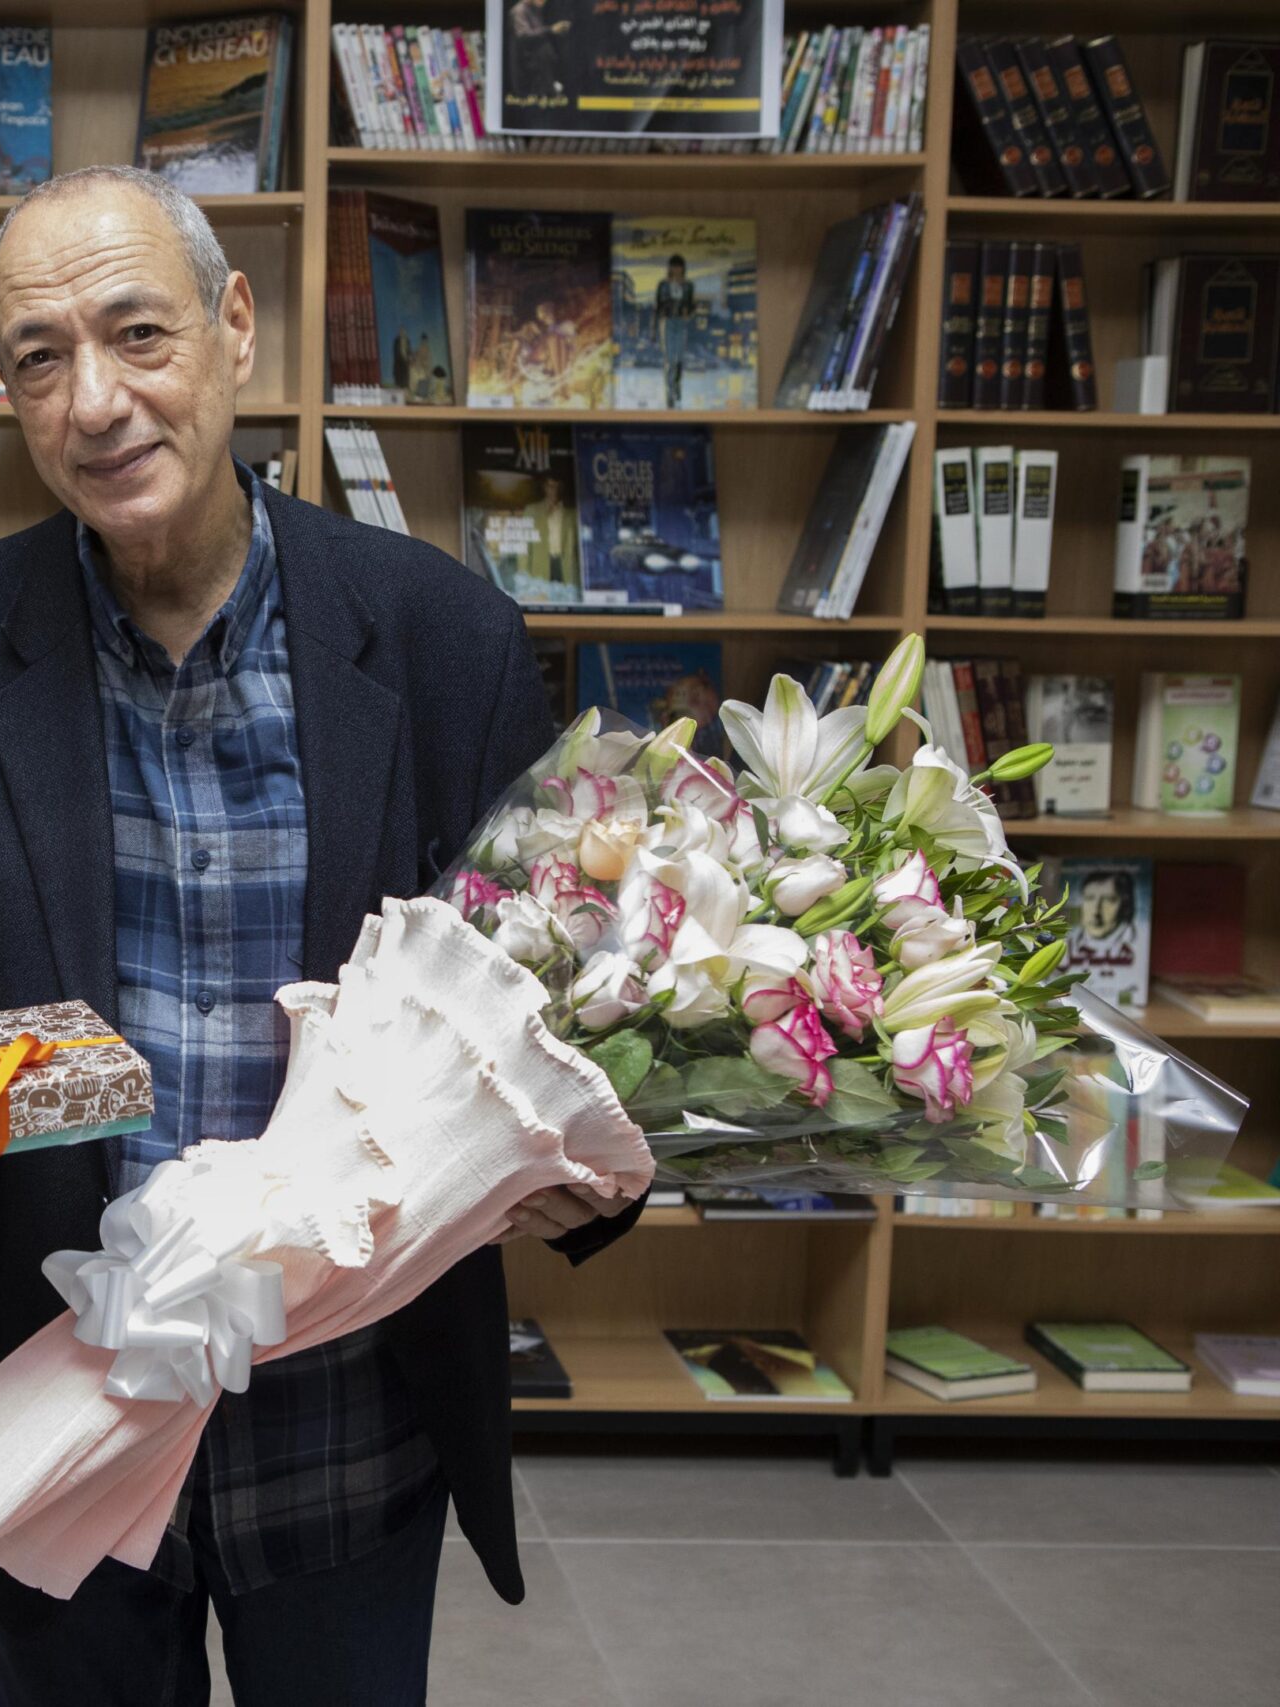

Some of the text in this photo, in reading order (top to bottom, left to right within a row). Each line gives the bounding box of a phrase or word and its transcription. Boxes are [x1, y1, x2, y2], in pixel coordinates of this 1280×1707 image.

[514, 425, 550, 471] XIII
[592, 452, 654, 482] CERCLES
[606, 481, 654, 501] POUVOIR
